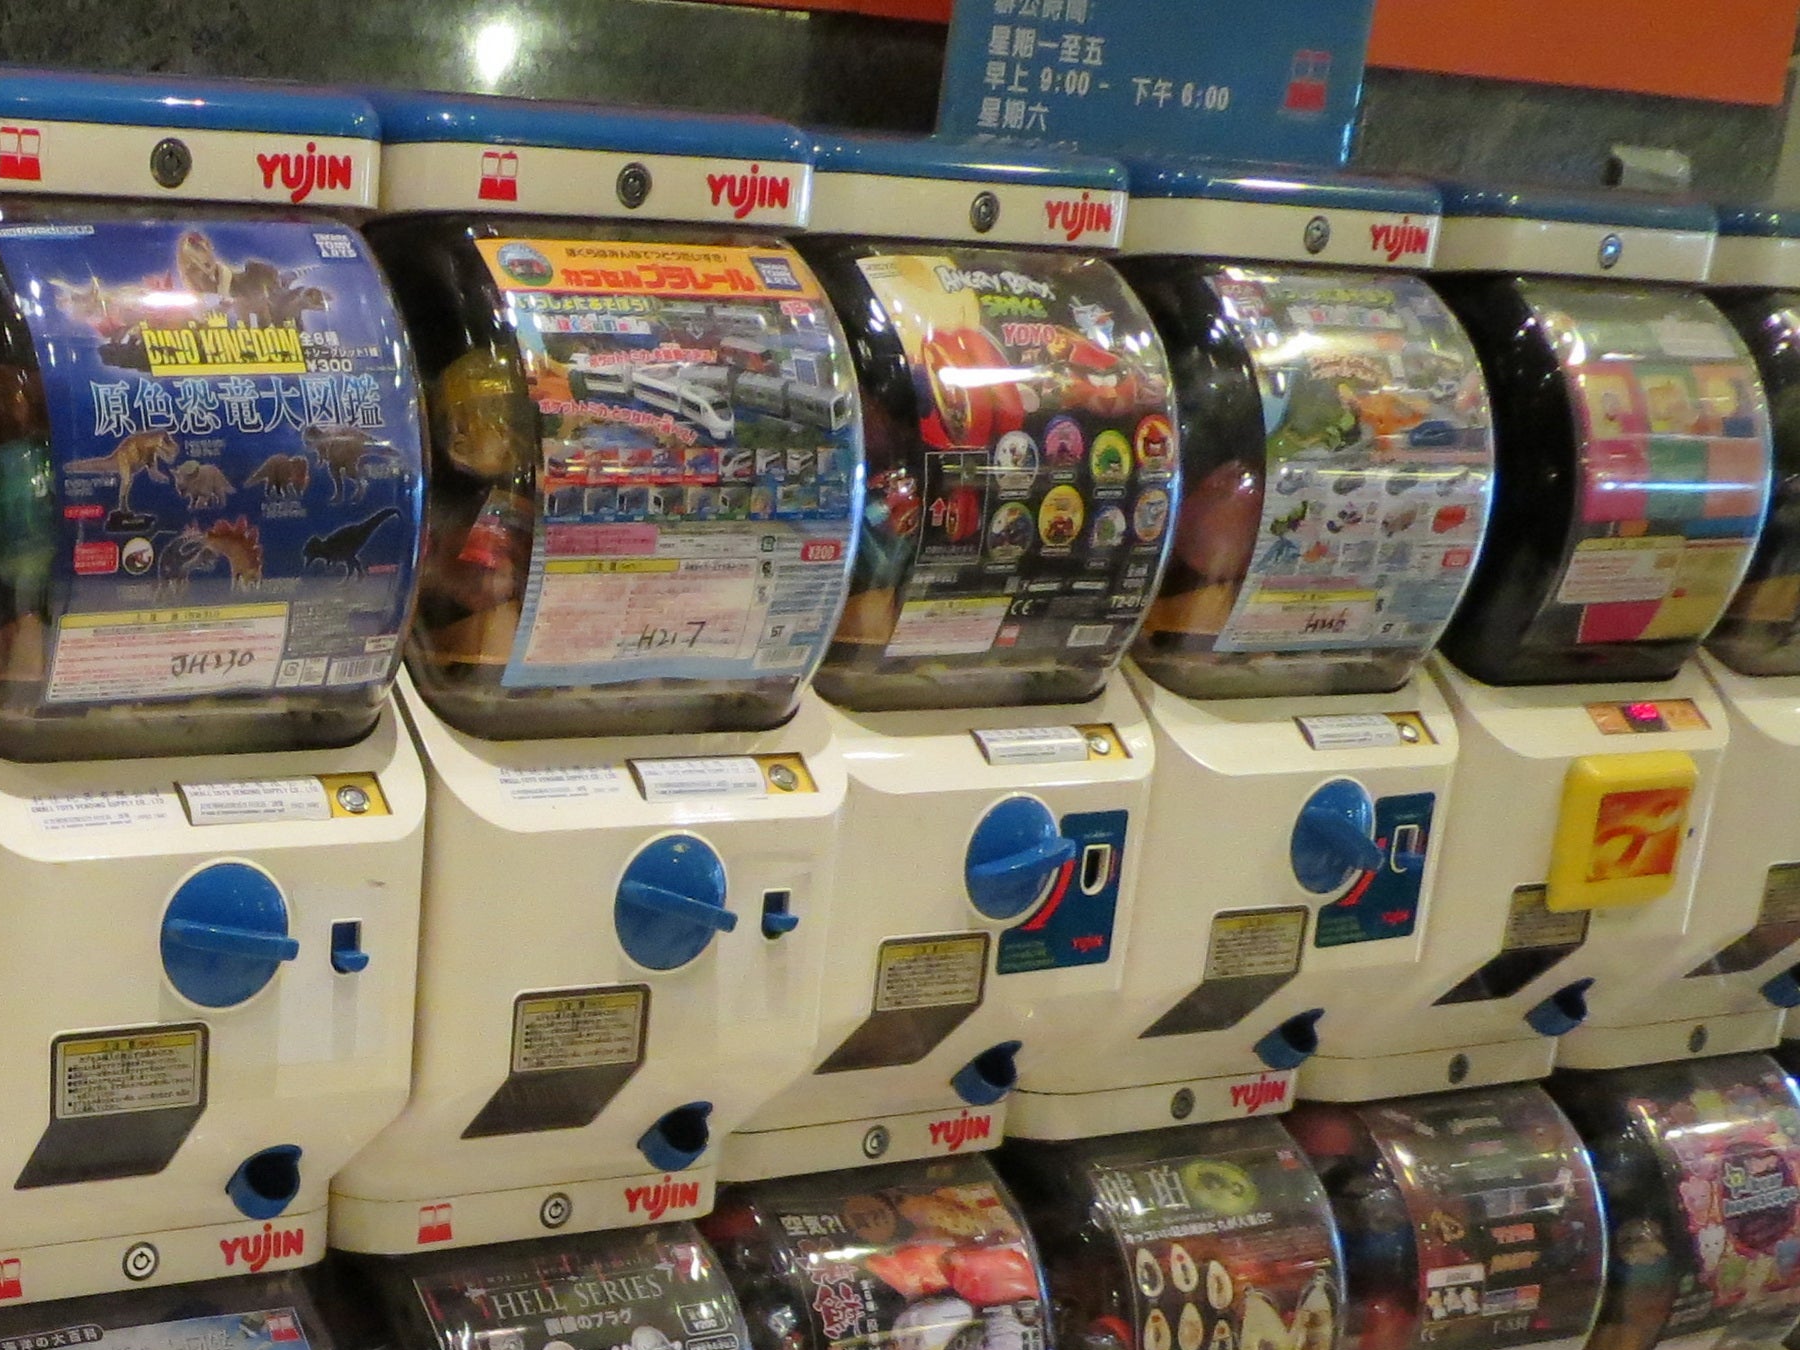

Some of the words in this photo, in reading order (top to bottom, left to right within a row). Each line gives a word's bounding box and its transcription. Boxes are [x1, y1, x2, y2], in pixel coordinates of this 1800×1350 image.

[988, 25, 1105, 66] 星期一至五
[983, 61, 1029, 93] 早上
[1039, 67, 1091, 97] 9:00
[1131, 77, 1174, 108] 下午
[977, 97, 1050, 132] 星期六
[306, 359, 353, 373] ¥300
[90, 376, 384, 437] 原色恐竜大図鑑
[491, 1288, 568, 1321] HELL
[573, 1274, 664, 1307] SERIES
